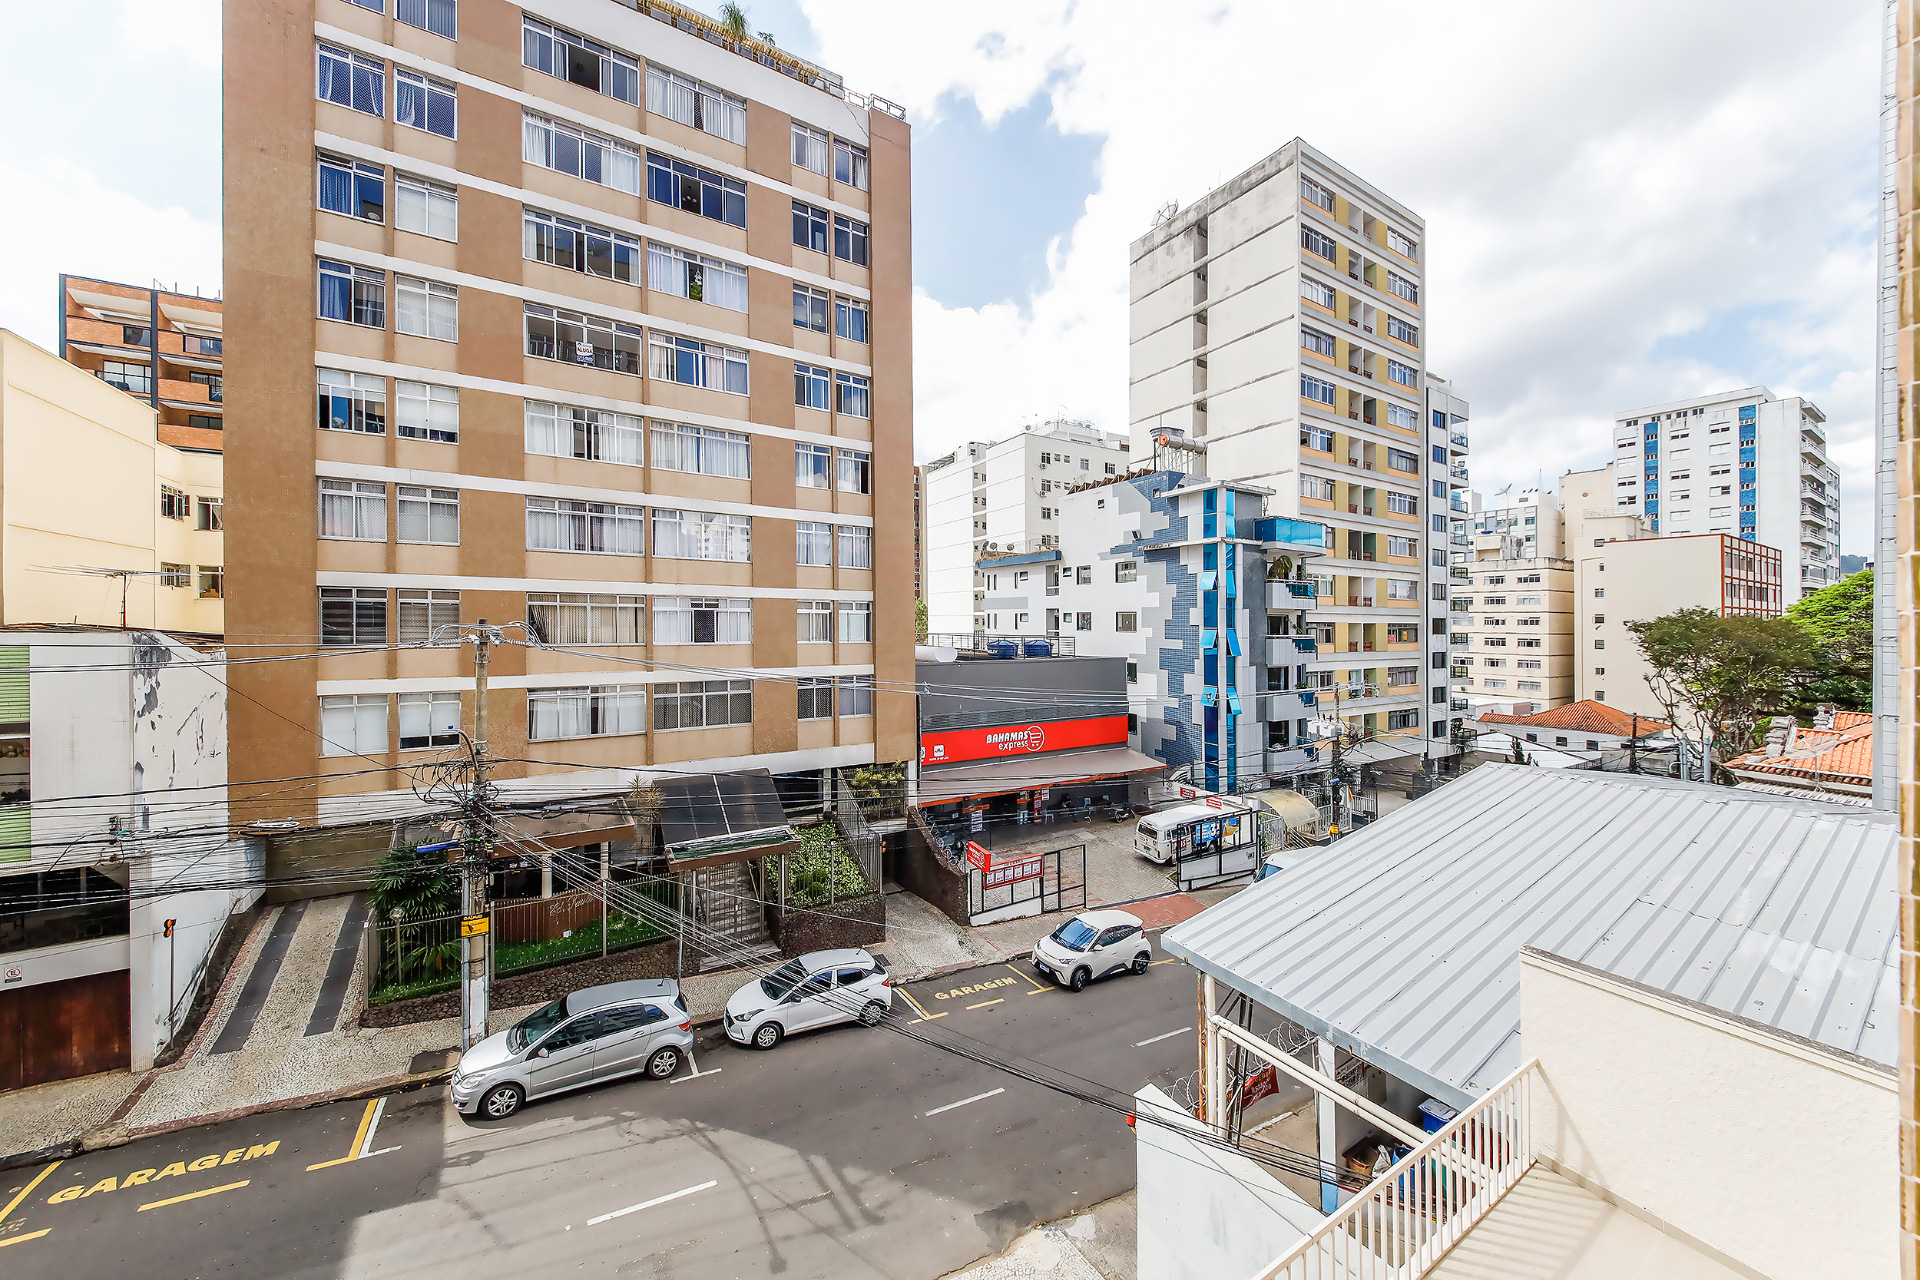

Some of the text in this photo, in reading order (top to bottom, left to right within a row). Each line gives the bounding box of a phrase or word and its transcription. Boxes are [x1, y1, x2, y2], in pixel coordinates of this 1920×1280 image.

[986, 730, 1029, 744] BAHAMAS
[998, 740, 1029, 751] express
[935, 977, 1017, 999] GARAGEM
[47, 1140, 281, 1204] GARAGEM
